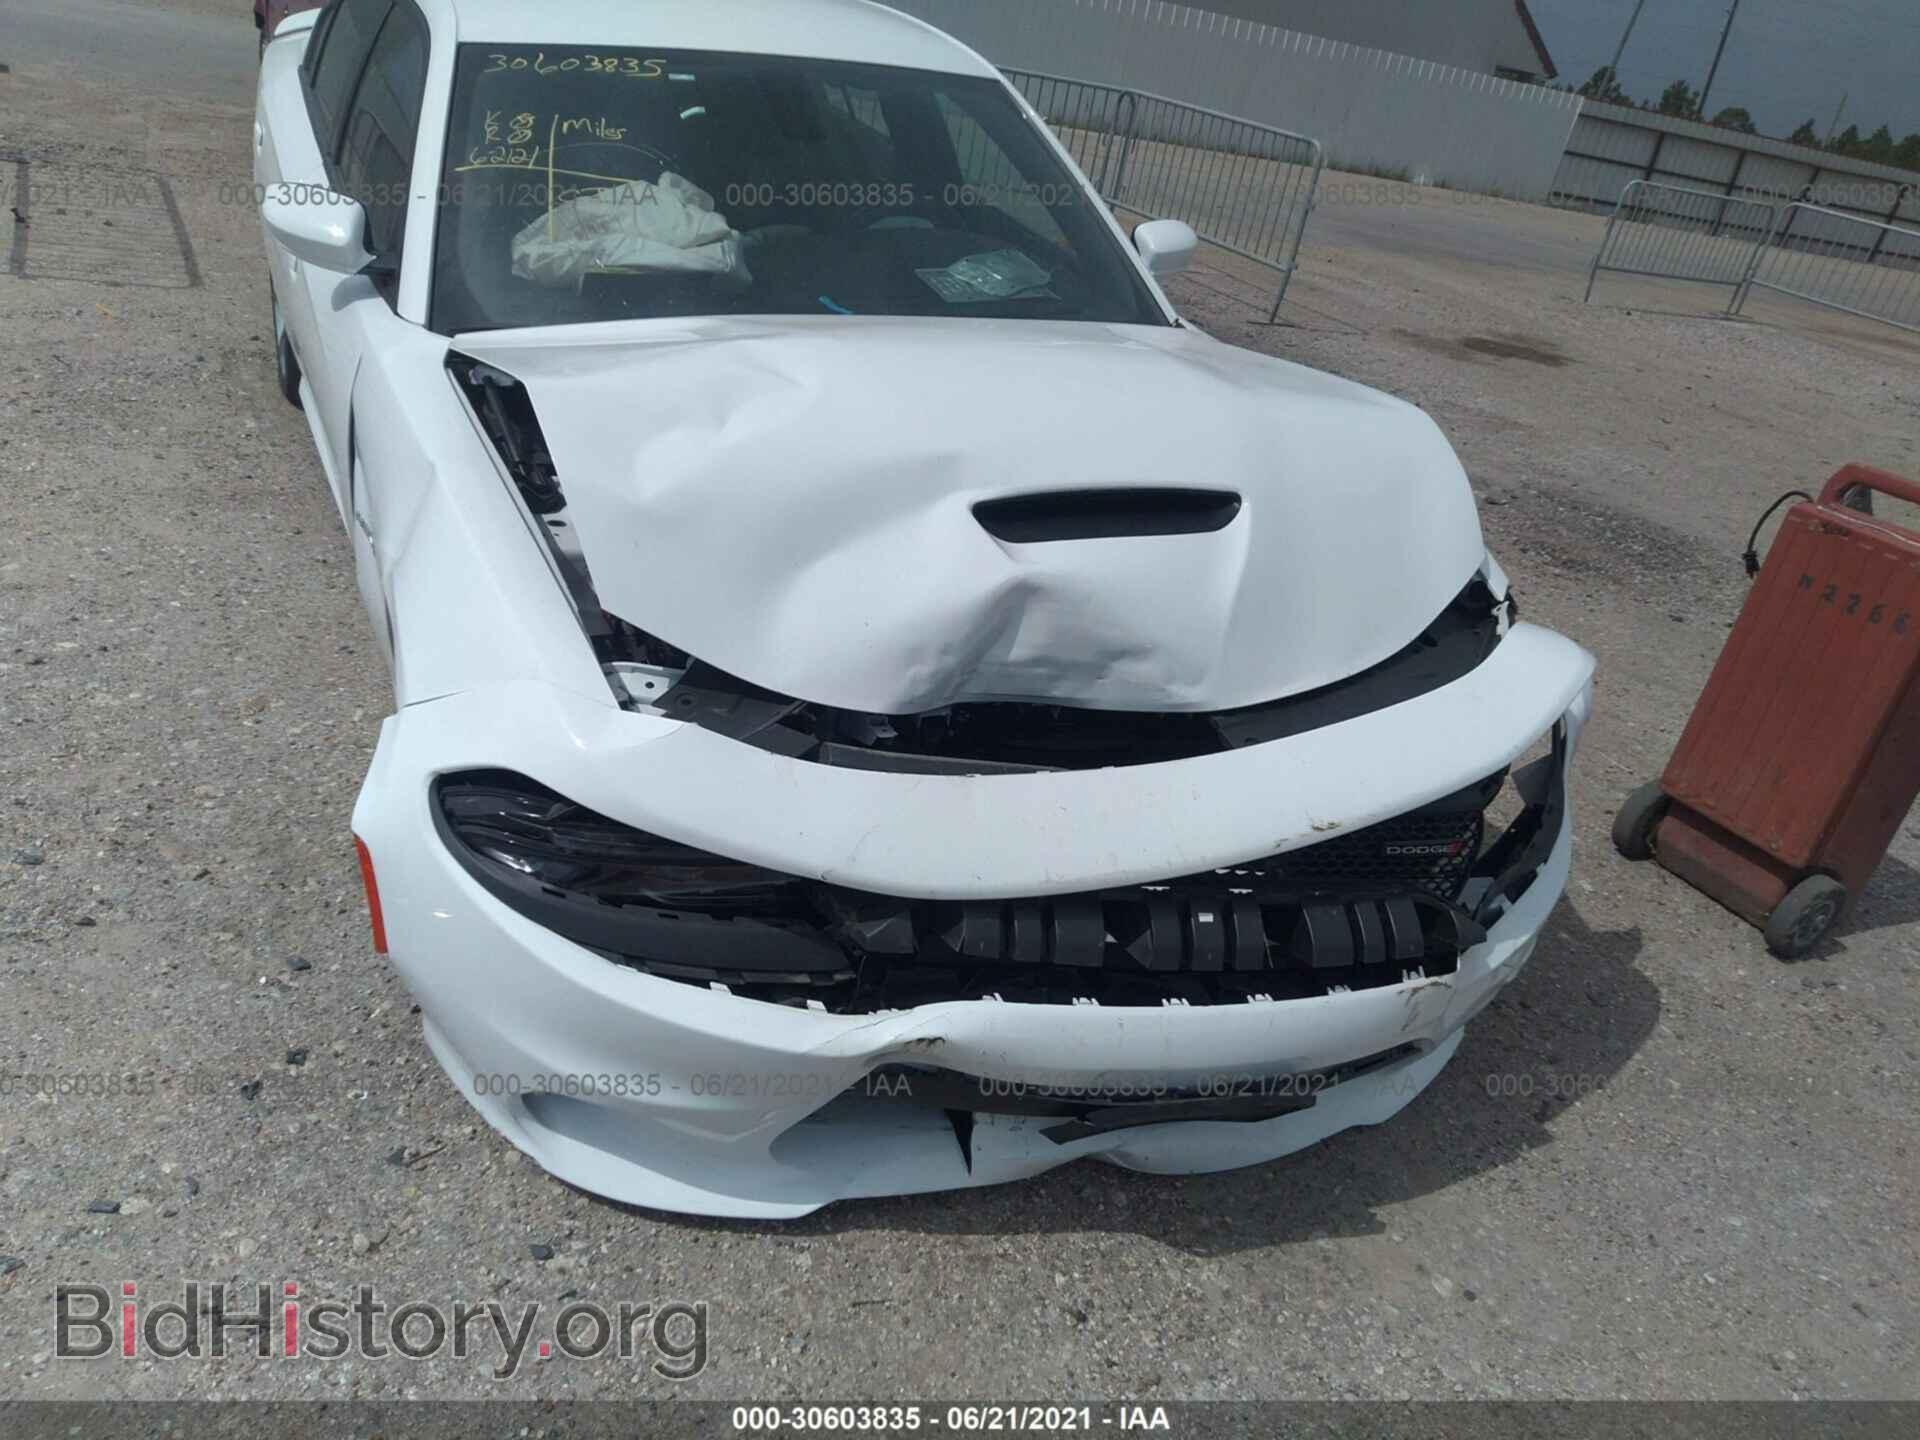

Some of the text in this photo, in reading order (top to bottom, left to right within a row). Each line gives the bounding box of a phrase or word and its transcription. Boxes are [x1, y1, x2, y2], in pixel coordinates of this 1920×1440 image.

[484, 52, 667, 77] 30603835
[561, 117, 626, 140] Miles
[1386, 845, 1450, 855] DODGE
